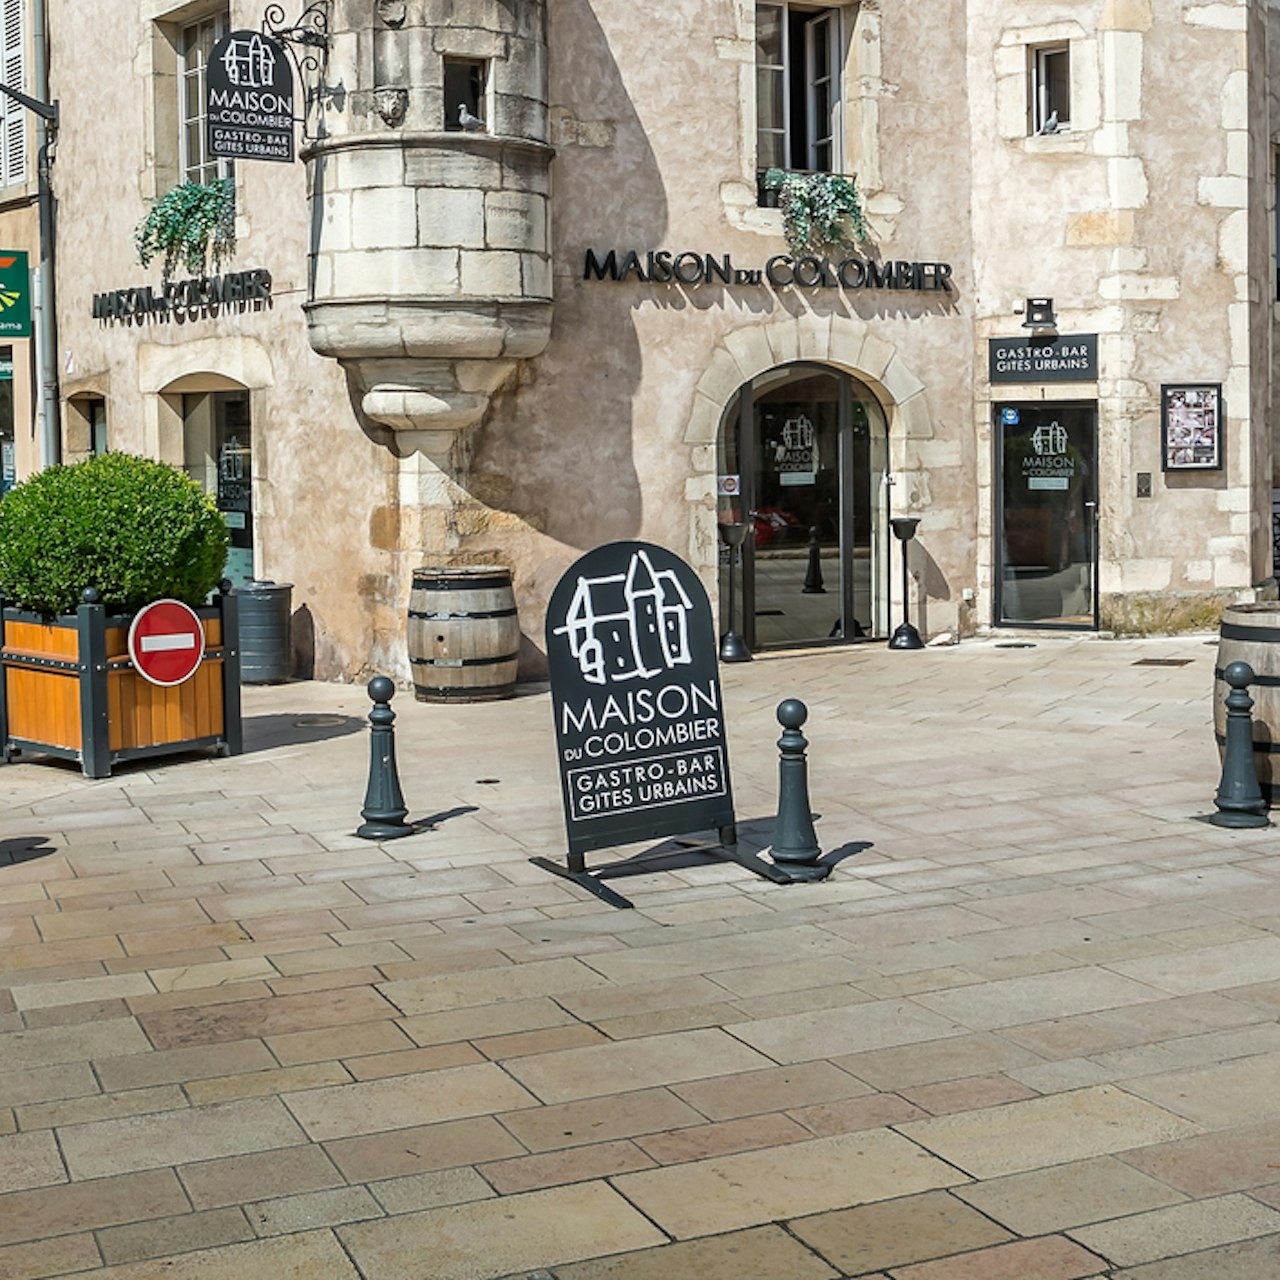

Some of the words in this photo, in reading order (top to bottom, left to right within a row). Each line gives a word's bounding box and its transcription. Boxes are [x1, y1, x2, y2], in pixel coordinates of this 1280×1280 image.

[209, 88, 293, 114] MAISON
[209, 113, 220, 121] DU
[220, 110, 293, 128] COLOMBIER
[214, 141, 244, 153] GITES
[245, 142, 289, 157] URBAINS
[583, 248, 732, 284] MAISON
[733, 269, 762, 286] DU
[765, 255, 953, 292] COLOMBIER
[996, 359, 1031, 372] GITES
[1034, 357, 1089, 370] URBAINS
[1022, 456, 1075, 468] MAISON
[561, 679, 719, 735] MAISON
[563, 746, 584, 762] DU
[583, 717, 720, 758] COLOMBIER
[575, 753, 716, 792] GASTRO-BAR
[578, 786, 634, 813] GITES
[638, 774, 719, 803] URBAINS
